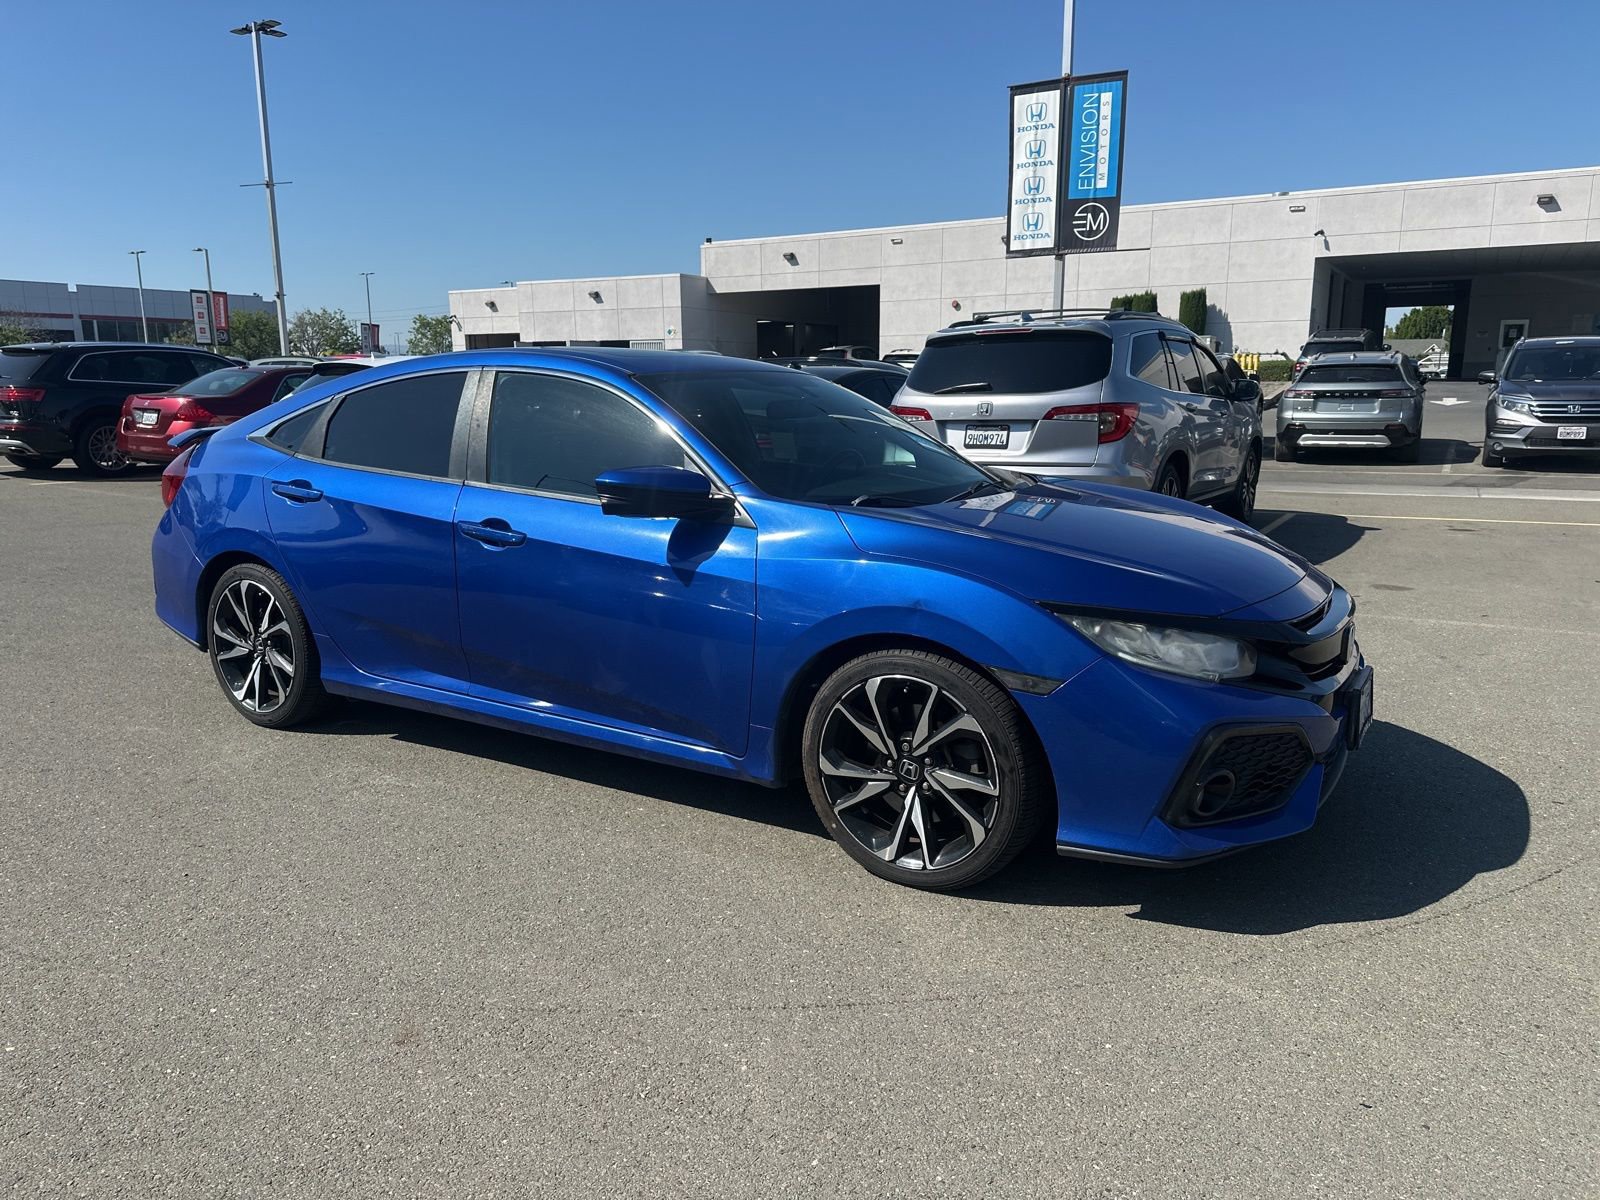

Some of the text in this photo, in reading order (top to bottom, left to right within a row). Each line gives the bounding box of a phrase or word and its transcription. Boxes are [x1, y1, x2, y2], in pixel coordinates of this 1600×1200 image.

[1017, 122, 1056, 133] HONDA
[1078, 93, 1099, 189] ENVISION
[1099, 101, 1110, 181] MOTORS
[1016, 159, 1054, 170] HONDA
[1014, 196, 1053, 205] HONDA
[1013, 232, 1051, 241] HONDA
